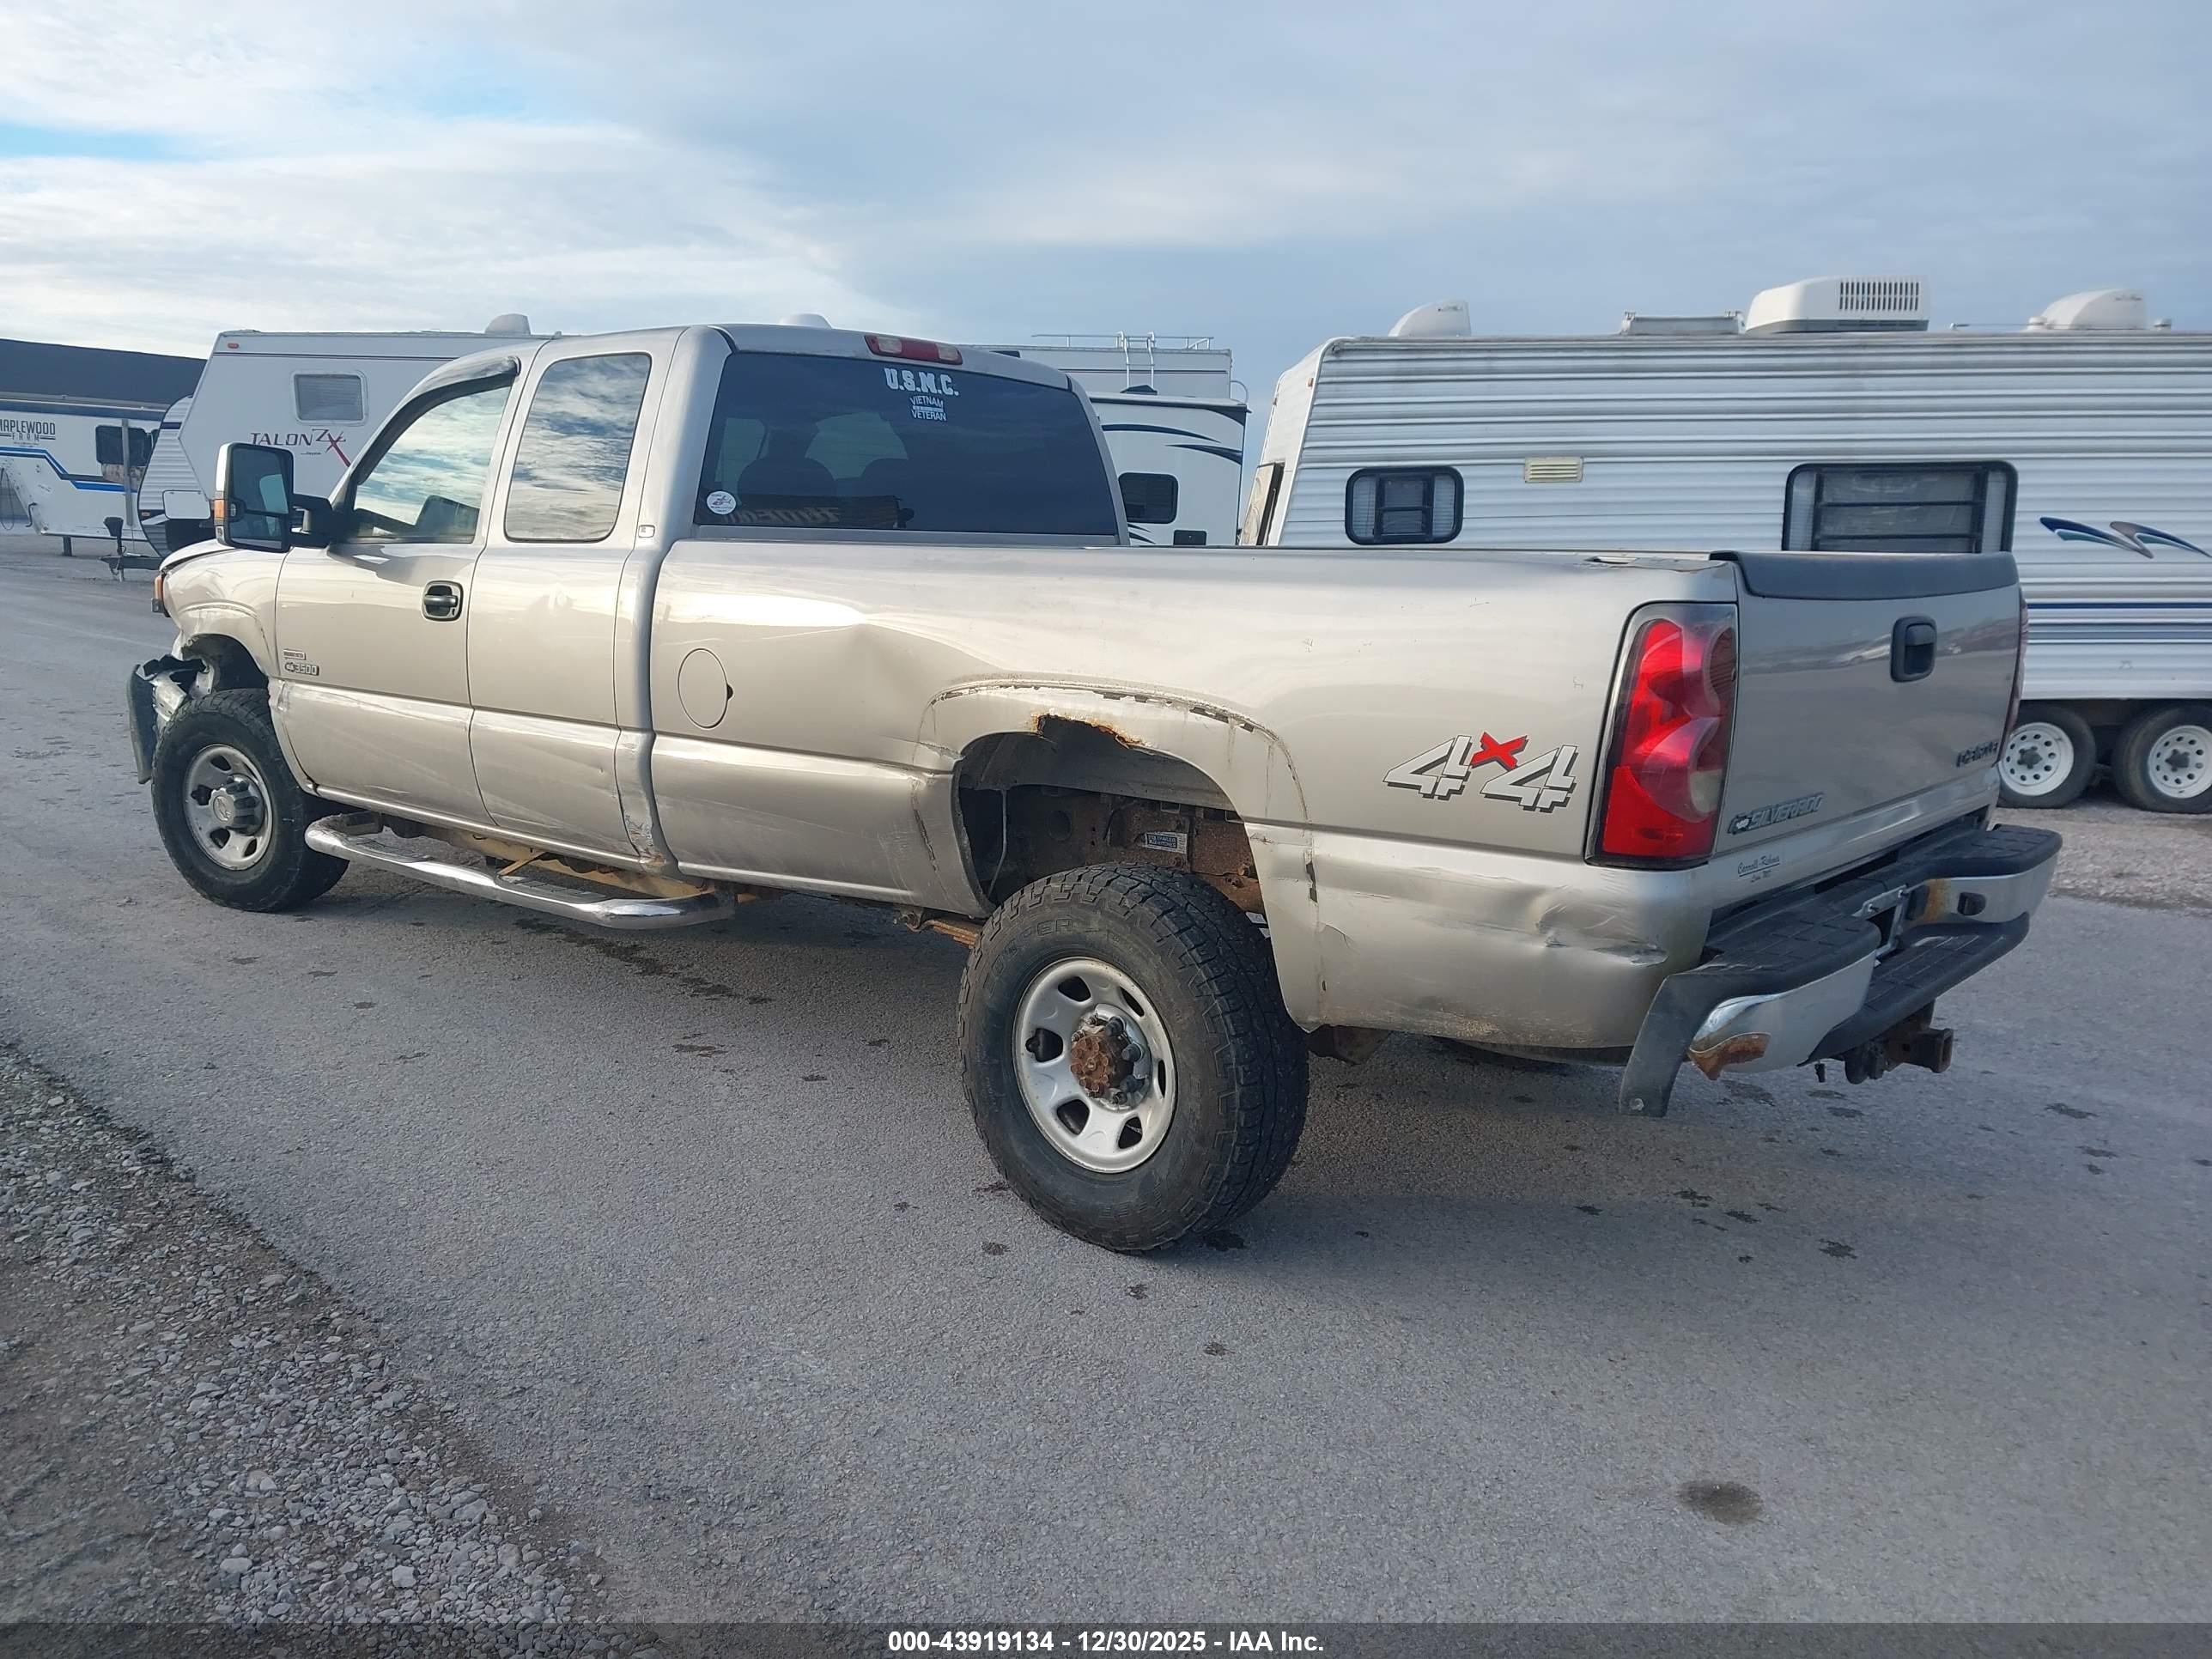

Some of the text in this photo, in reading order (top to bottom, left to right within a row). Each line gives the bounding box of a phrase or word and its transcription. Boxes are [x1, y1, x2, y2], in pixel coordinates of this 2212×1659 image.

[884, 368, 959, 396] U.S.M.C.
[910, 396, 944, 408] VIETNAM
[912, 410, 946, 421] VETERAN
[250, 432, 313, 447] TALON
[1747, 793, 1824, 830] SILVERADO
